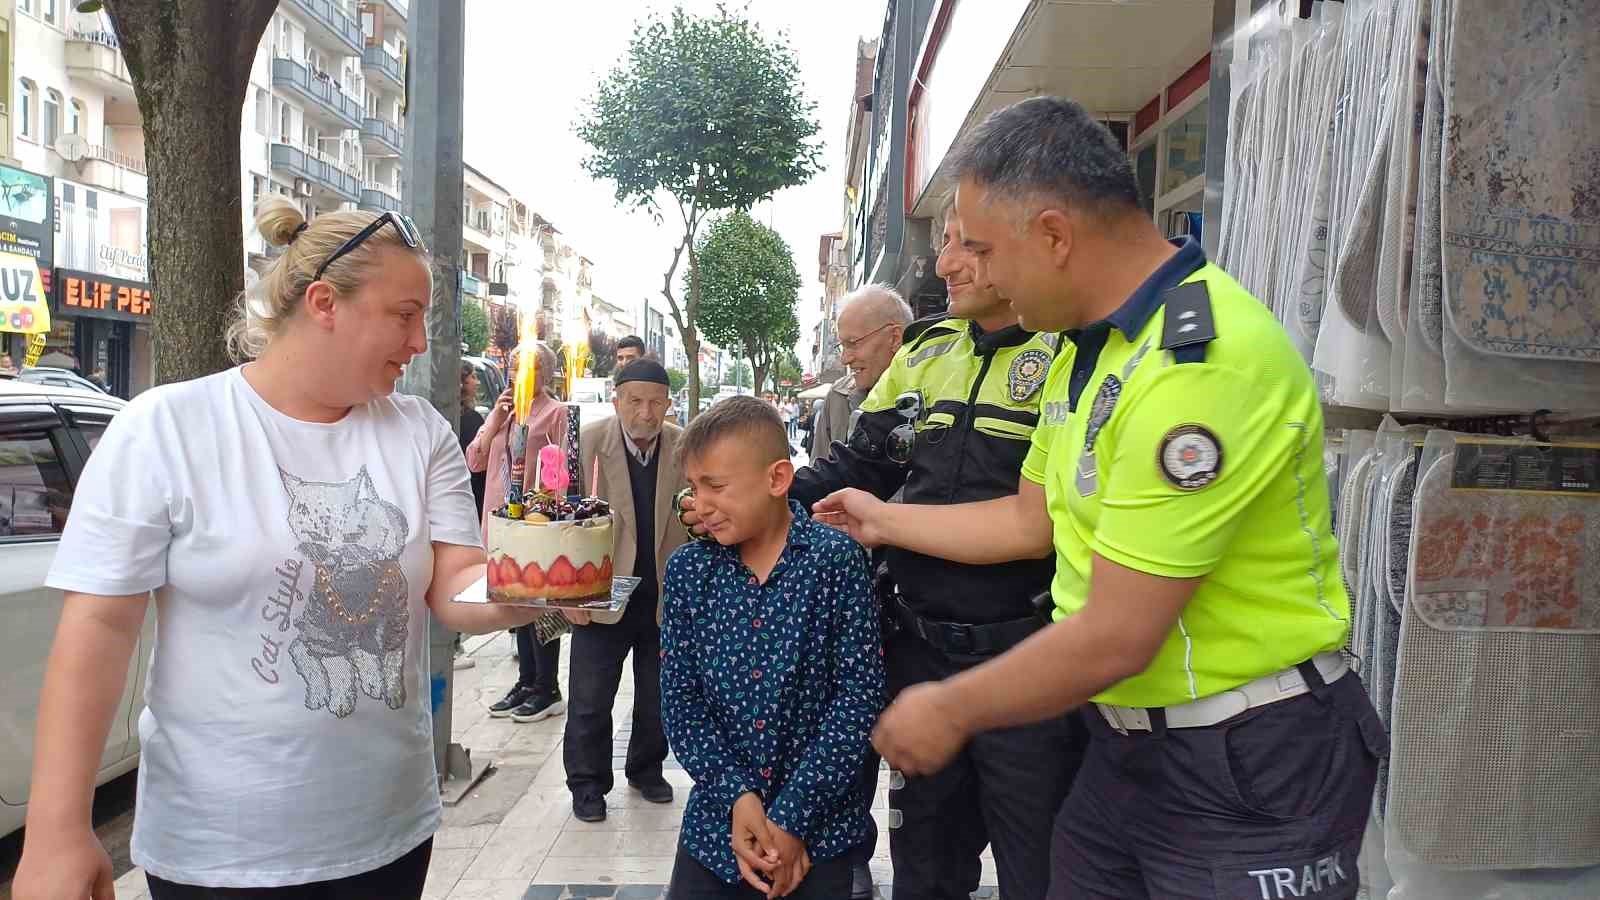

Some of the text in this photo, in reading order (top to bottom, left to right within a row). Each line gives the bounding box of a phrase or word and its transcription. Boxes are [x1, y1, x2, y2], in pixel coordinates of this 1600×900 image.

[0, 267, 37, 302] UZ
[251, 558, 304, 684] Cat Style
